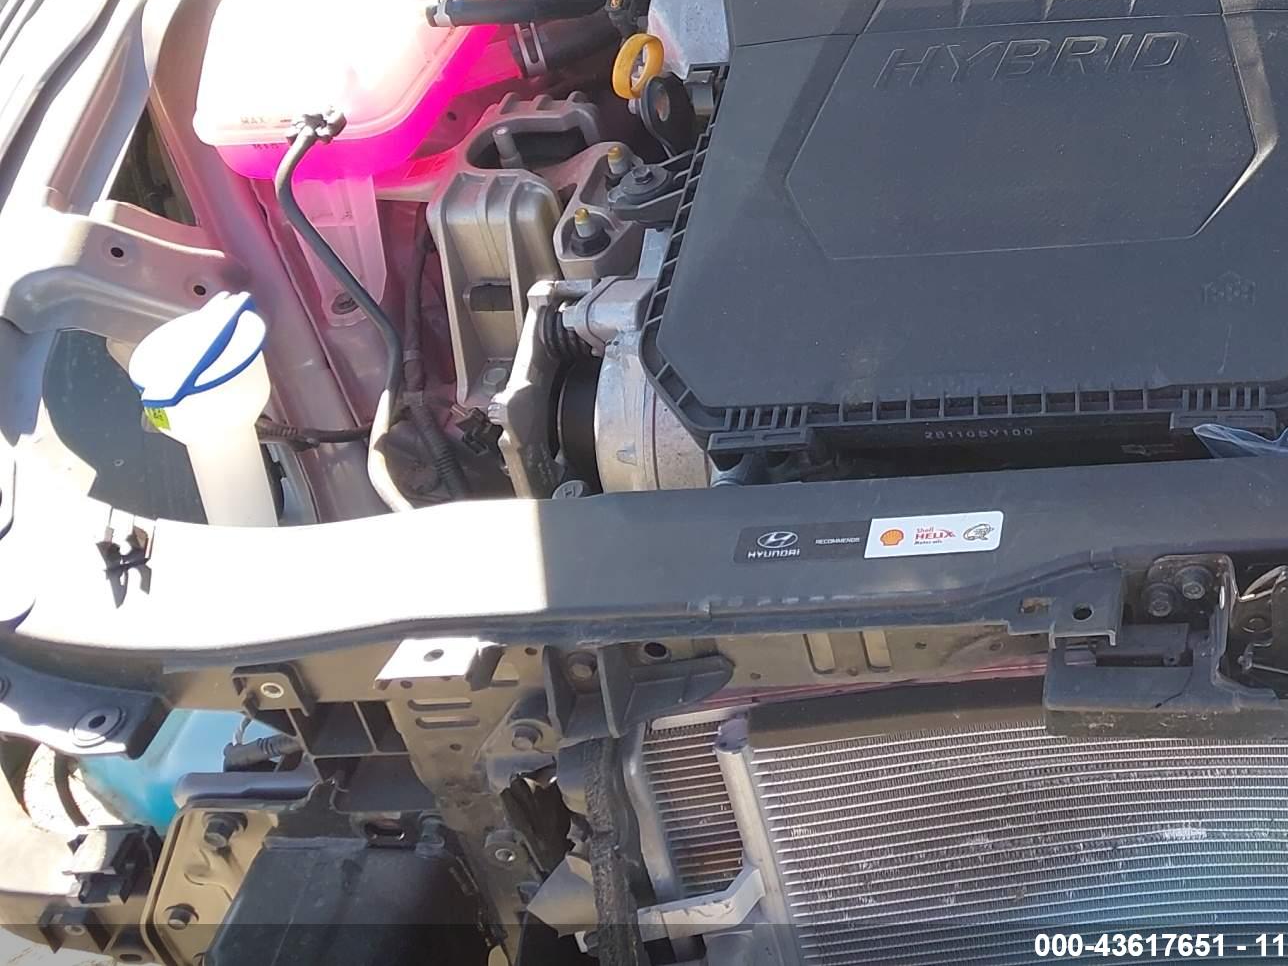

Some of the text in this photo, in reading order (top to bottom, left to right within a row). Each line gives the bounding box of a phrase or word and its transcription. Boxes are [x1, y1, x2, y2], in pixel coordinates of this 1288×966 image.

[873, 32, 1188, 88] HYBRID
[747, 548, 800, 558] HYUNDAI
[915, 529, 956, 540] HELIX
